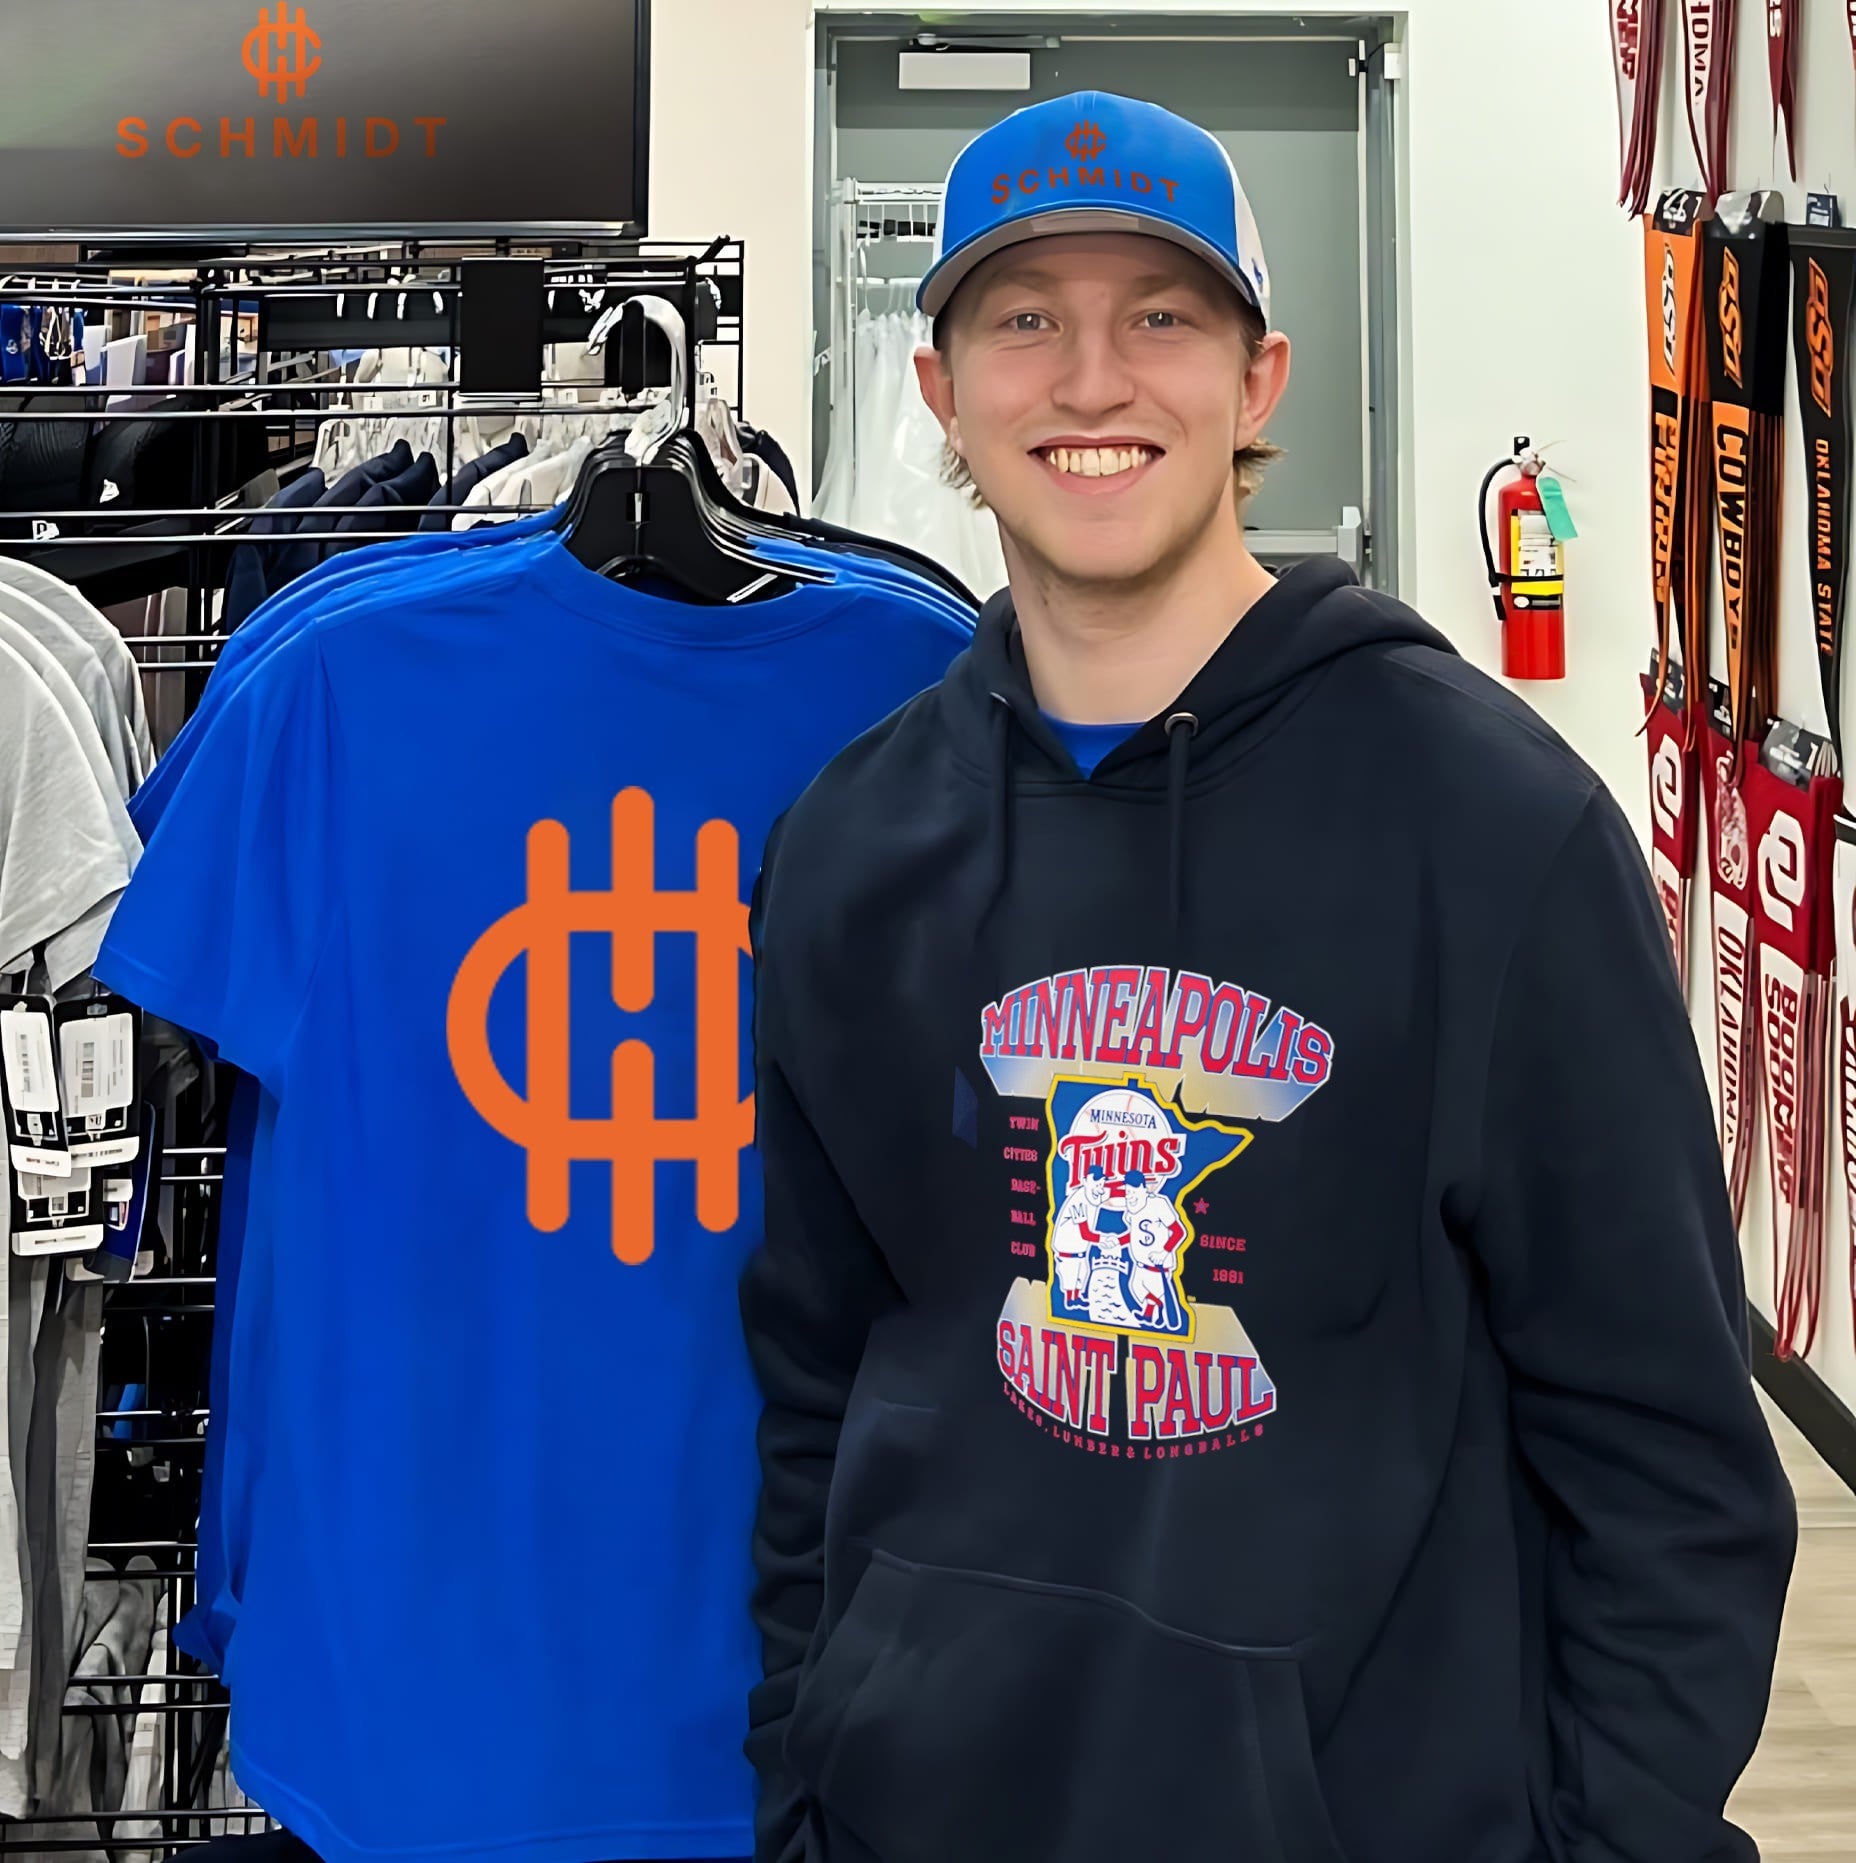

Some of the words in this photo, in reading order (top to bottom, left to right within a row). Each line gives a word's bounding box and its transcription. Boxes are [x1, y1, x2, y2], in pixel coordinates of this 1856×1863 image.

[115, 117, 448, 158] SCHMIDT
[991, 167, 1180, 205] SCHMIDT
[1815, 439, 1832, 570] OKLAHOMA
[980, 965, 1334, 1085] MINNEAPOLIS
[1009, 1116, 1040, 1131] TWIN
[1090, 1108, 1158, 1130] MINNESOTA
[1060, 1130, 1181, 1189] Twins
[1200, 1233, 1247, 1252] SINCE
[998, 1320, 1118, 1434] SAINT
[1127, 1343, 1277, 1440] PAUL
[1053, 1425, 1120, 1457] LUMBER
[1126, 1445, 1136, 1459] &
[1143, 1423, 1264, 1460] LONGBALLS
